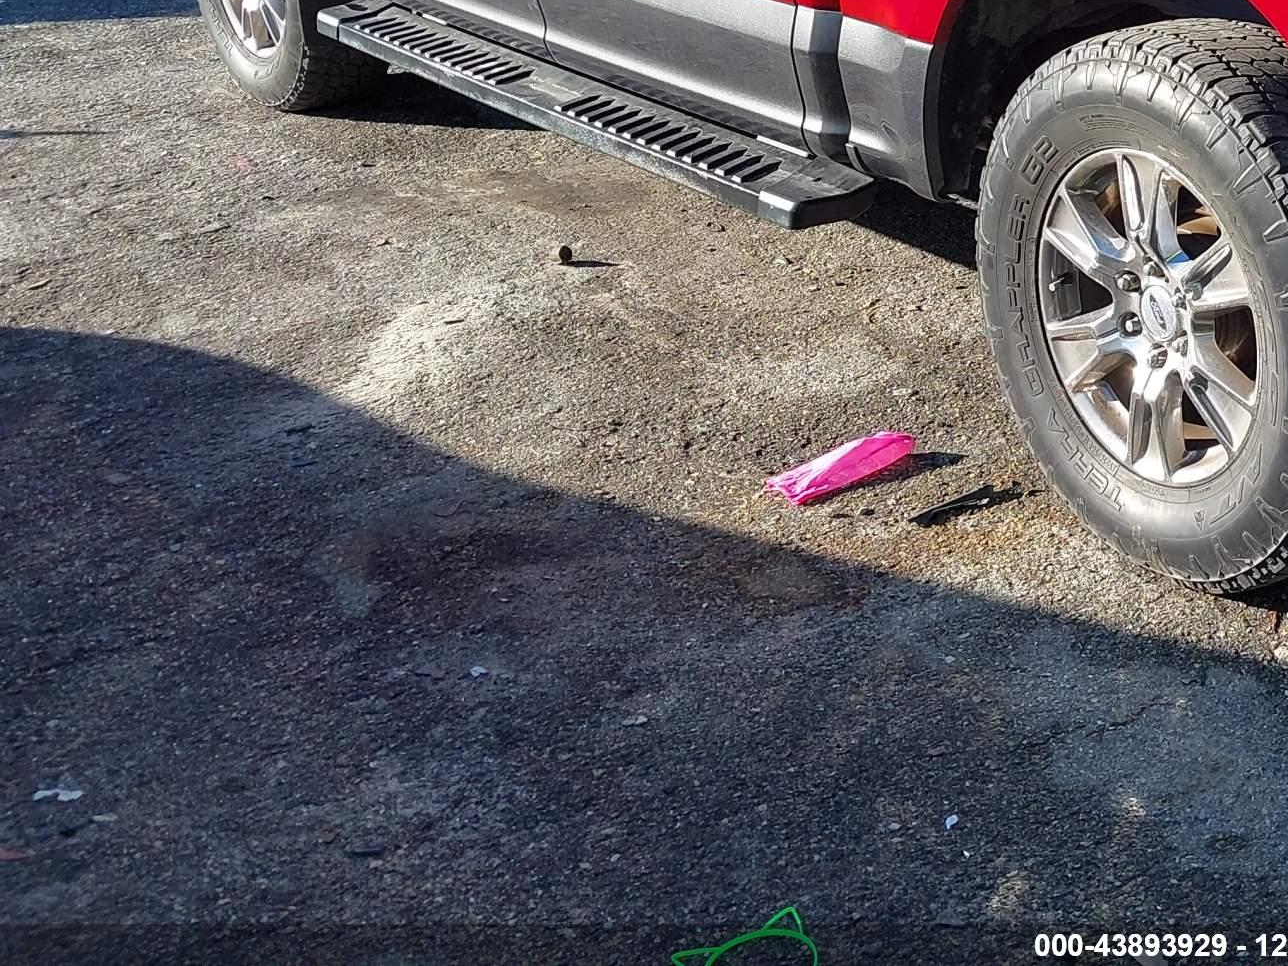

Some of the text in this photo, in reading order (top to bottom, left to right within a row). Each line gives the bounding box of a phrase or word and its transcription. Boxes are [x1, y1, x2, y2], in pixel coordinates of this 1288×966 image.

[1021, 135, 1060, 185] G2
[1001, 194, 1044, 399] GRAPPLER
[1046, 408, 1123, 513] TERRA
